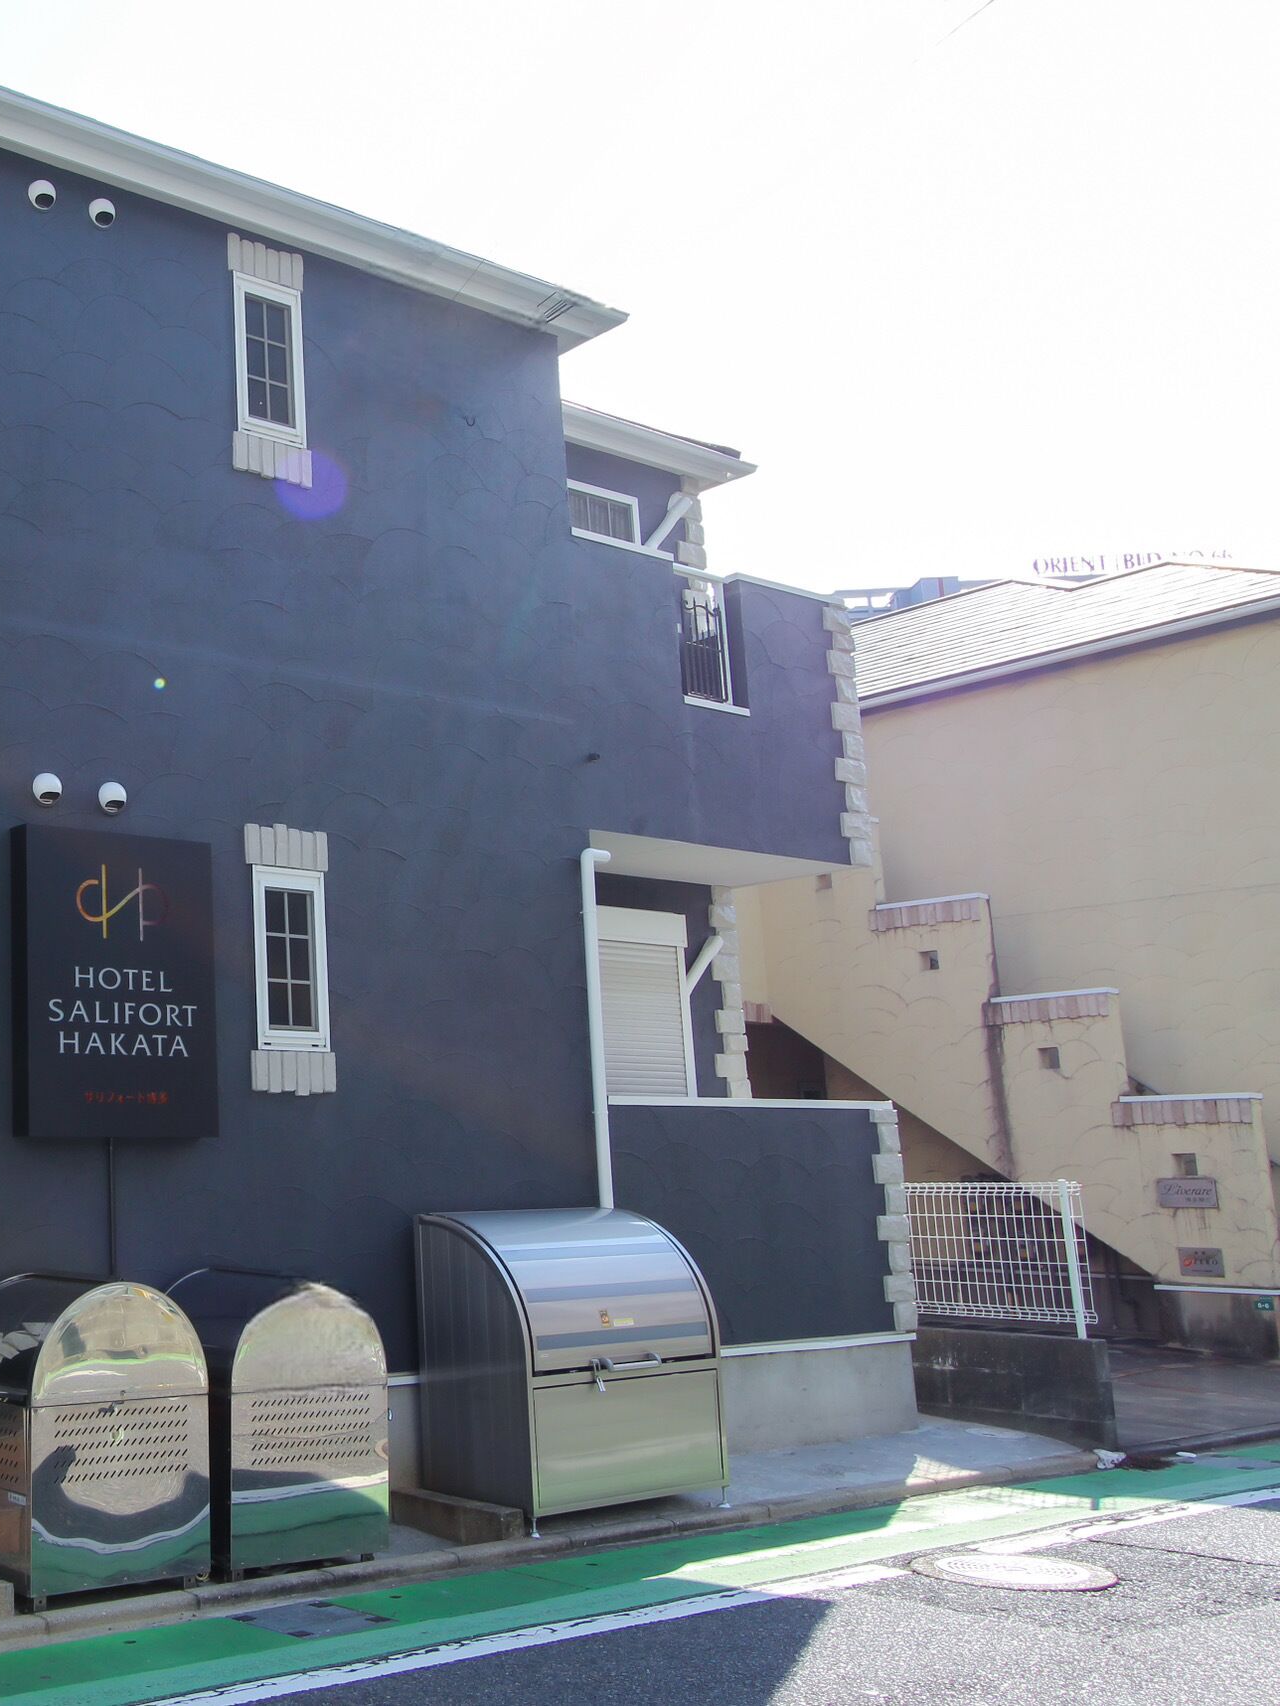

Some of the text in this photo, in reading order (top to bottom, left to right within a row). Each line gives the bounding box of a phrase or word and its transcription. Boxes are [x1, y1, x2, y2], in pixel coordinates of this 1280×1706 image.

[74, 966, 173, 992] HOTEL
[48, 998, 198, 1027] SALIFORT
[58, 1031, 189, 1057] HAKATA
